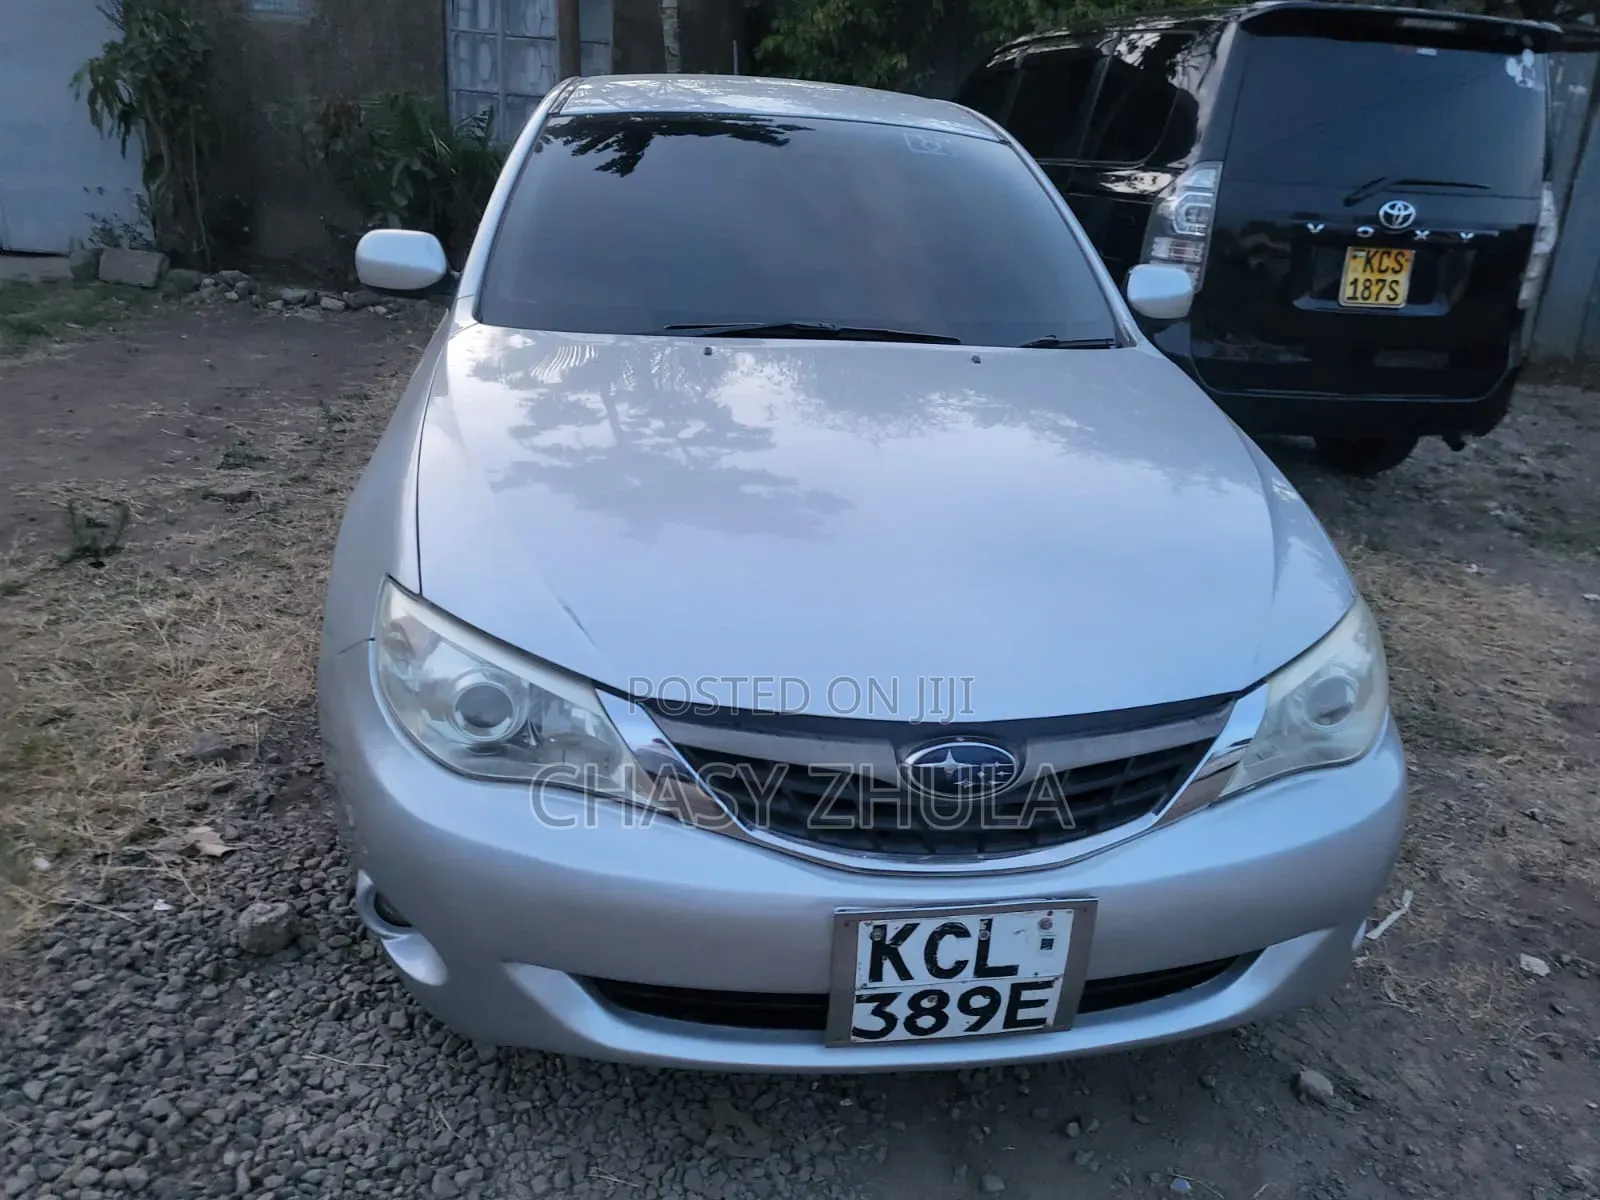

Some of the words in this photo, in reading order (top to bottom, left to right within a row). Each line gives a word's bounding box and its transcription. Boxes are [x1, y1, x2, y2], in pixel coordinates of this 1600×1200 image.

[1307, 222, 1476, 242] VOXY
[1362, 249, 1406, 275] KCS
[1346, 277, 1400, 302] 187S
[868, 917, 1020, 983] KCL
[851, 979, 1056, 1040] 389E
